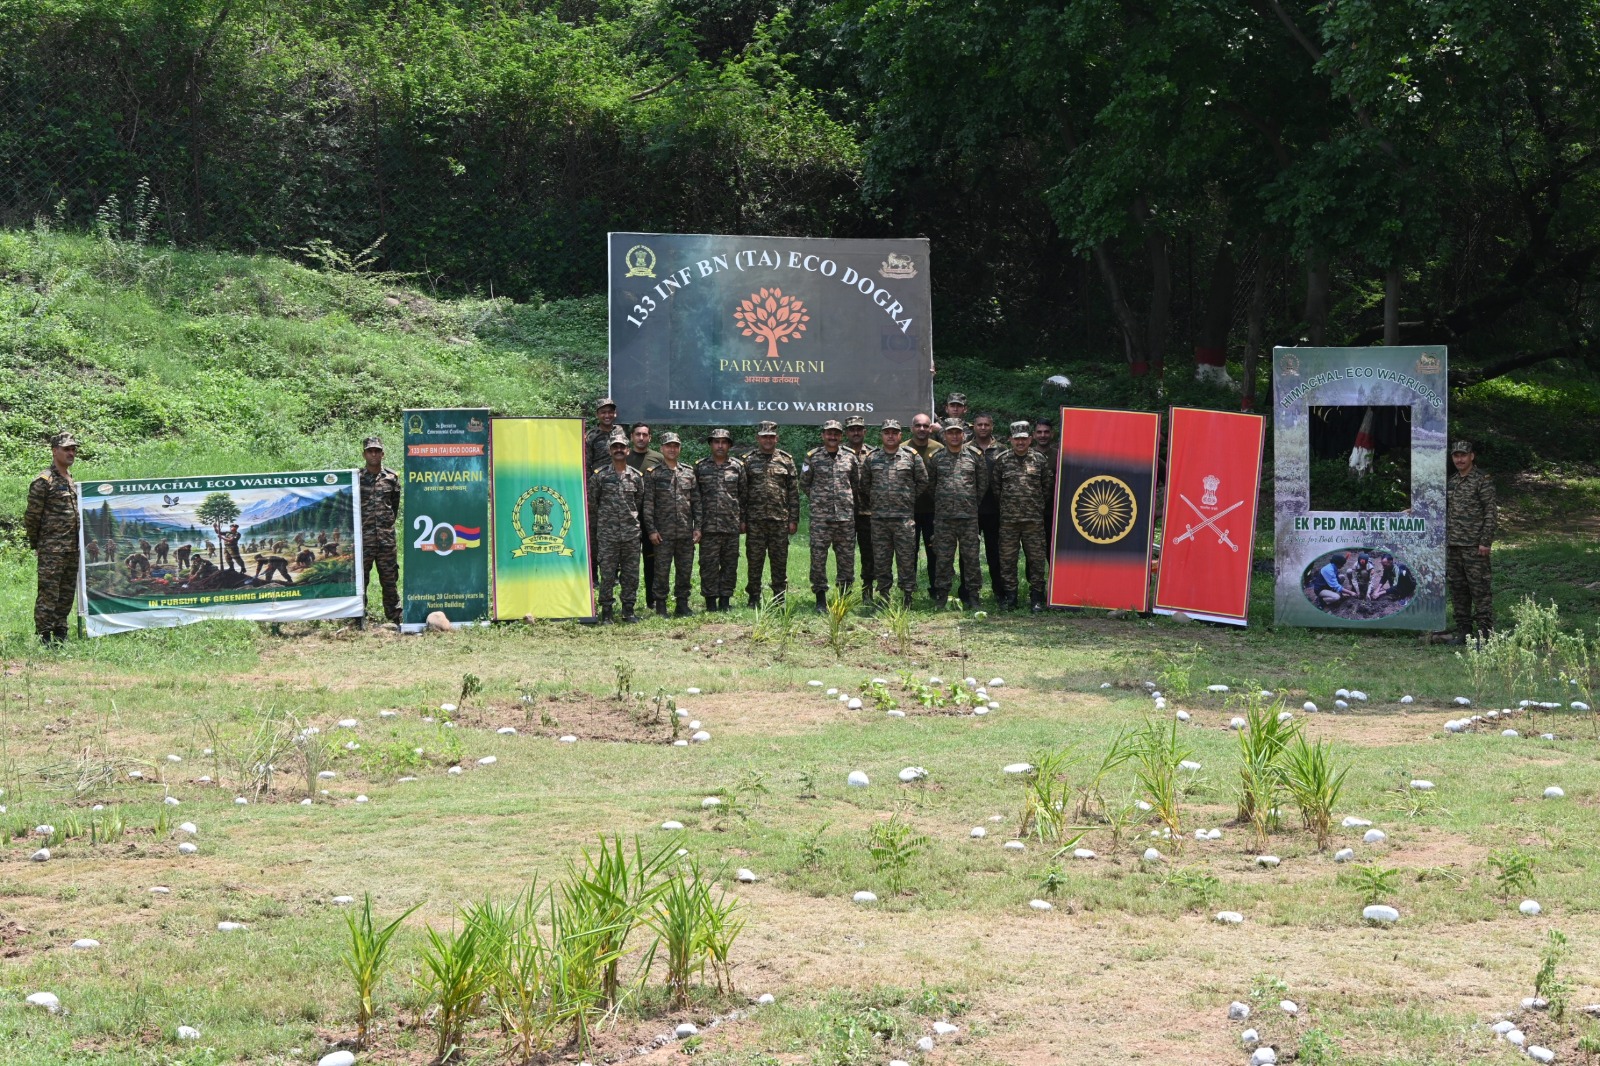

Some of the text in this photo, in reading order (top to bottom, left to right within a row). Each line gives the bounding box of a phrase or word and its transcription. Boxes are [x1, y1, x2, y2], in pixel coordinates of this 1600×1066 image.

[626, 249, 914, 334] 133 INF BN (TA) ECO DOGRA
[719, 358, 825, 374] PARYAVARNI
[1280, 367, 1443, 409] HIMACHAL ECO WARRIORS
[668, 400, 874, 413] HIMACHAL ECO WARRIORS
[119, 476, 318, 492] HIMACHAL ECO WARRIORS
[409, 470, 483, 483] PARYAVARNI
[1294, 517, 1425, 531] EK PED MAA KE NAAM
[161, 597, 198, 607] PURSUIT
[213, 592, 257, 603] GREENING
[258, 590, 302, 599] HIMACHAL
